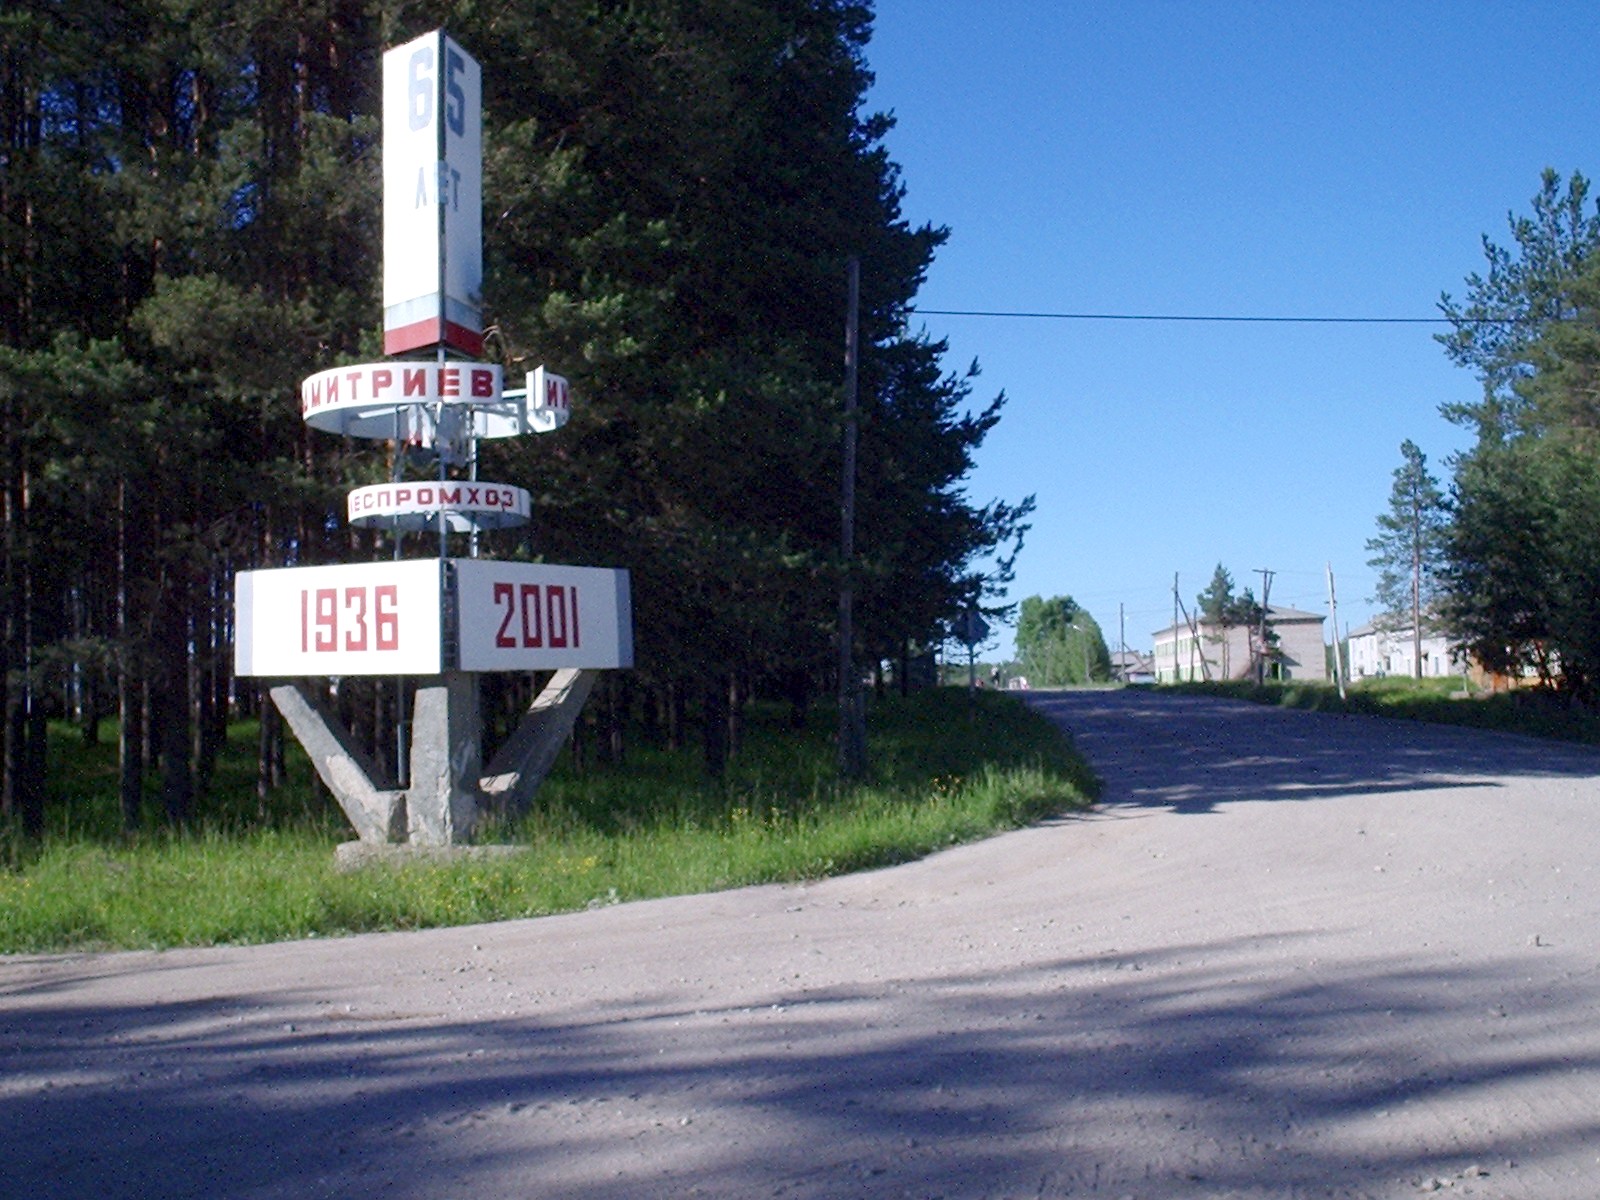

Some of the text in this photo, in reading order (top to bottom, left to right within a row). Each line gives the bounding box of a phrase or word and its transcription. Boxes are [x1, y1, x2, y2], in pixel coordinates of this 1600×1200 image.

[408, 46, 465, 138] 65
[350, 487, 514, 513] ЕСПРОМХОЗ
[301, 585, 398, 652] 1936
[494, 583, 580, 648] 2001
